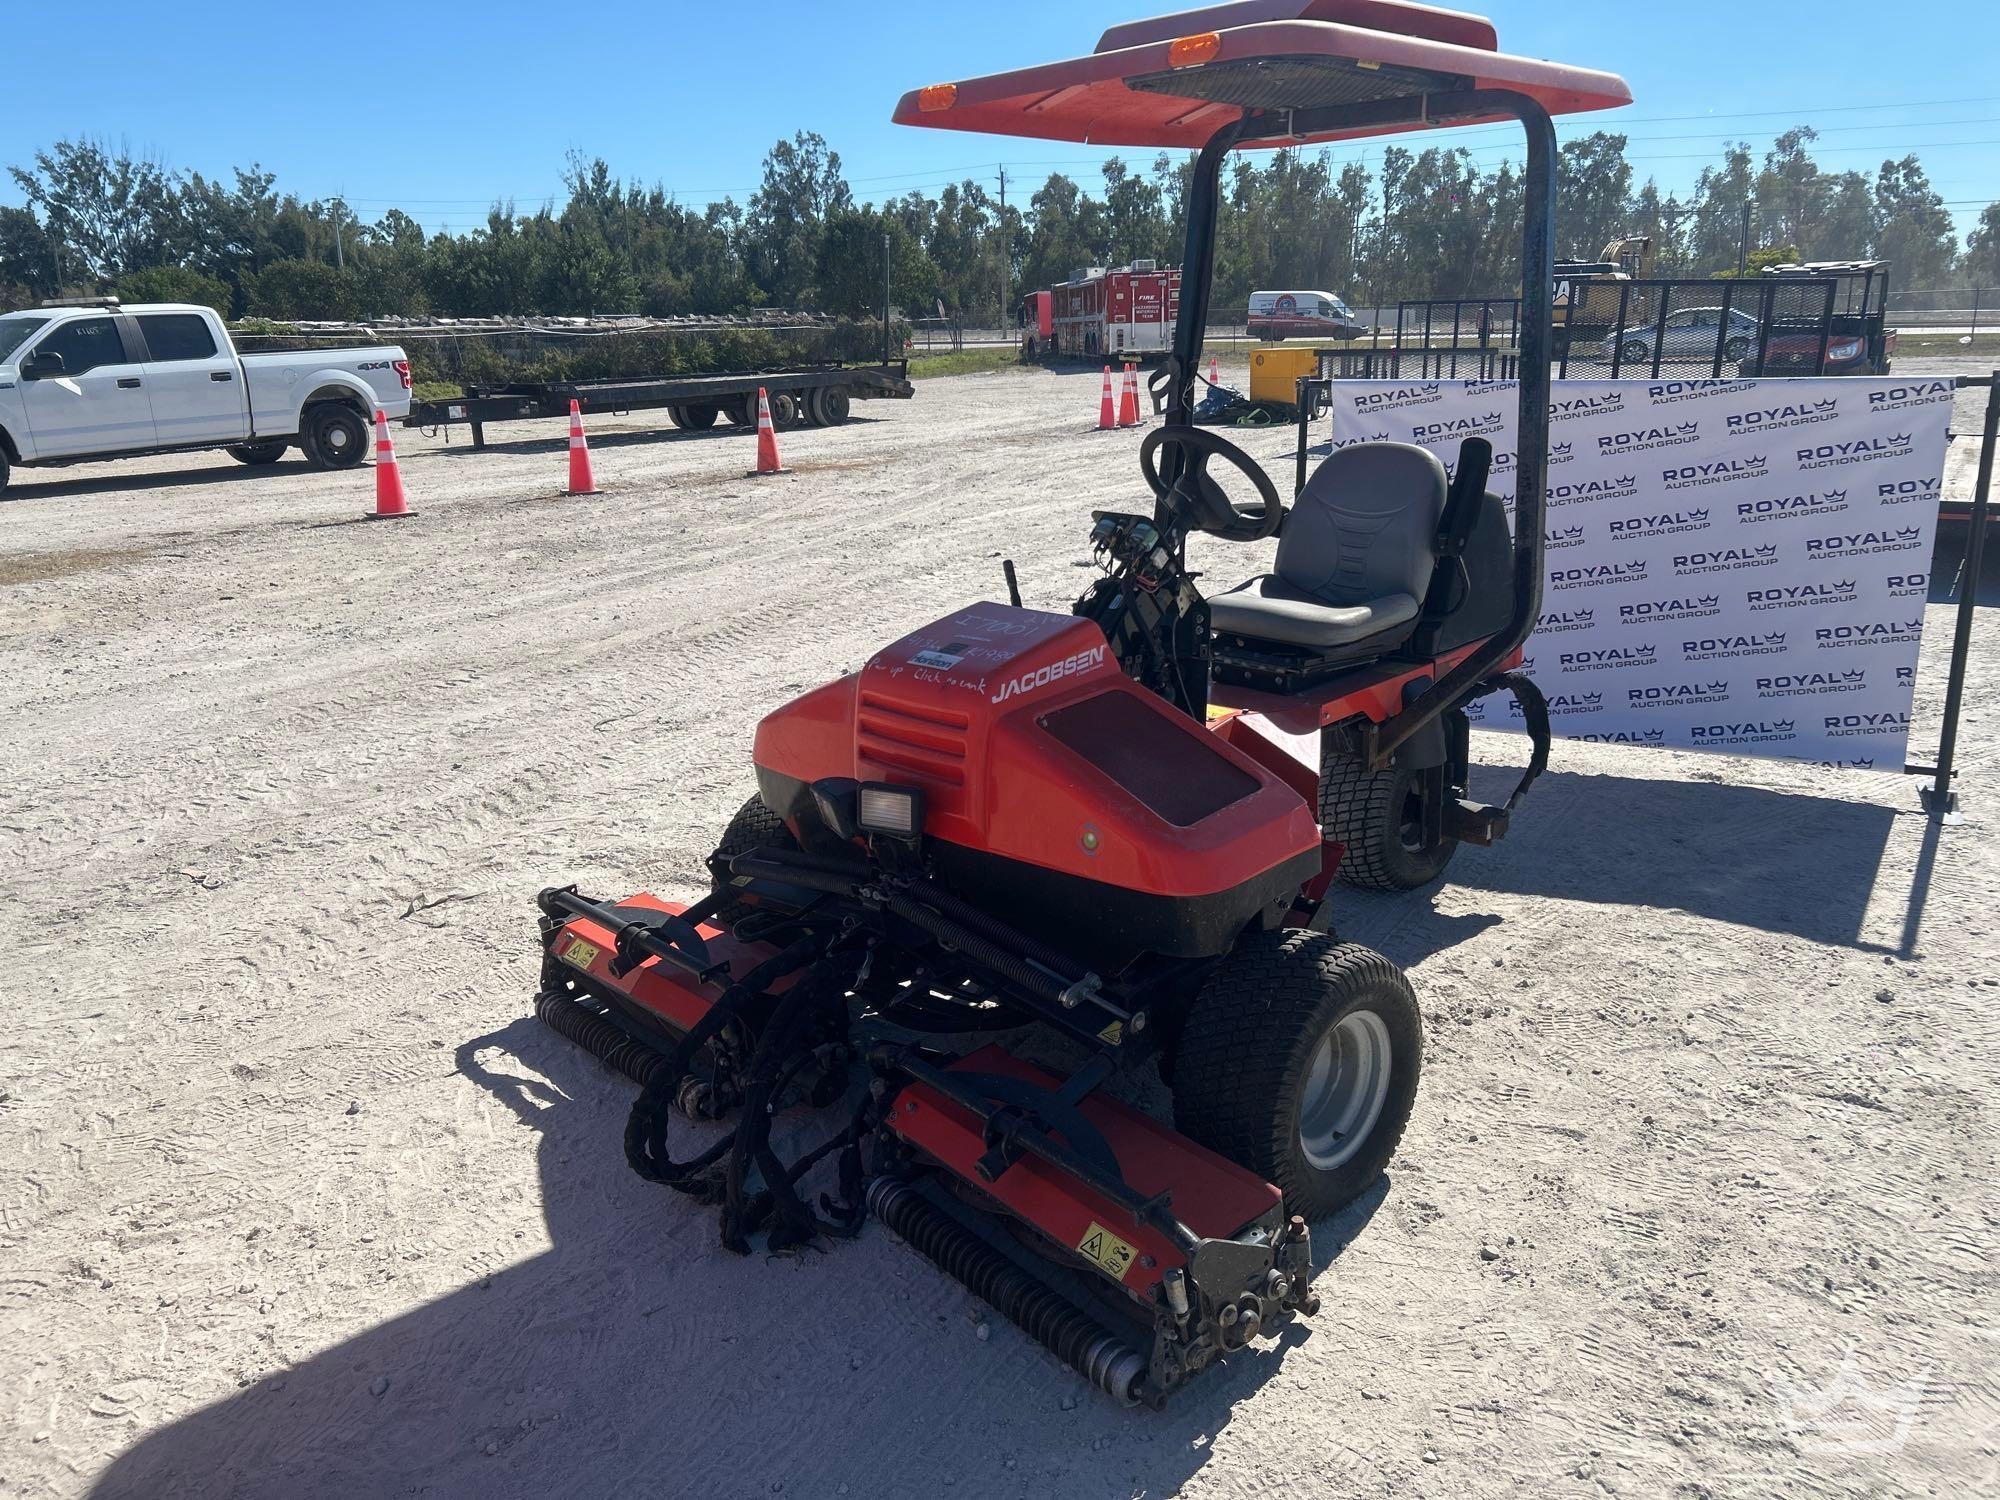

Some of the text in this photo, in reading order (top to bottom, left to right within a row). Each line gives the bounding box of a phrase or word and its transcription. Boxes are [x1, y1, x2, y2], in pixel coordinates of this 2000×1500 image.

[1355, 388, 1421, 406] ROYAL
[1467, 382, 1516, 396] AUCTION
[1652, 382, 1756, 405] AUCTION GROUP
[1358, 396, 1442, 414] AUCTION GROUP
[1549, 398, 1602, 414] OYAL
[1583, 405, 1624, 417] GROUP
[1871, 396, 1936, 412] AUCTION
[1727, 404, 1813, 427] ROYAL
[1729, 413, 1838, 436] AUCTION GROUP
[1413, 417, 1482, 437] ROYAL
[1416, 425, 1504, 446] AUCTION GROUP
[1598, 426, 1676, 448] ROYAL
[1600, 435, 1700, 456] AUCTION GROUP
[1797, 439, 1886, 461] ROYAL
[1799, 448, 1913, 470] AUCTION GROUP
[1663, 460, 1744, 481] ROYAL
[1664, 470, 1768, 490] AUCTION GROUP
[1878, 478, 1941, 496] ROY
[1596, 489, 1638, 500] GROUP
[1738, 495, 1823, 515] ROYAL
[1739, 504, 1848, 524] AUCTION GROUP
[1610, 512, 1688, 532] ROYAL
[1612, 522, 1710, 541] AUCTION GROUP
[1545, 540, 1585, 550] GROUP
[1806, 531, 1896, 551] ROYAL
[1673, 548, 1754, 567] ROYAL
[1808, 542, 1921, 560] AUCTION GROUP
[1551, 564, 1626, 582] ROYAL
[1675, 558, 1778, 576] AUCTION GROUP
[1552, 574, 1648, 591] AUCTION GROUP
[1747, 584, 1832, 602] ROYAL
[1619, 598, 1698, 616] ROYAL
[1749, 594, 1858, 611] AUCTION GROUP
[1537, 612, 1574, 625] YAL
[1622, 608, 1720, 625] AUCTION GROUP
[1555, 622, 1595, 632] GROUP
[1816, 622, 1904, 640] ROYAL
[1683, 636, 1763, 652] ROYAL
[1818, 635, 1920, 649] AUCTION GROU
[1560, 648, 1635, 664] ROYAL
[1685, 646, 1787, 661] AUCTION GROUP
[992, 645, 1104, 704] JACOBSEN
[1562, 659, 1657, 673] AUCTION GROUP
[1756, 673, 1841, 689] ROYAL
[1629, 684, 1707, 700] ROYAL
[1758, 684, 1866, 698] AUCTION GROUP
[1563, 706, 1603, 715] GROUP
[1630, 695, 1729, 708] AUCTION GROUP
[1824, 713, 1910, 728] ROYAL
[1691, 723, 1772, 737] ROYAL
[1826, 728, 1887, 737] AUCTION
[1693, 734, 1796, 746] AUCTION GROUP
